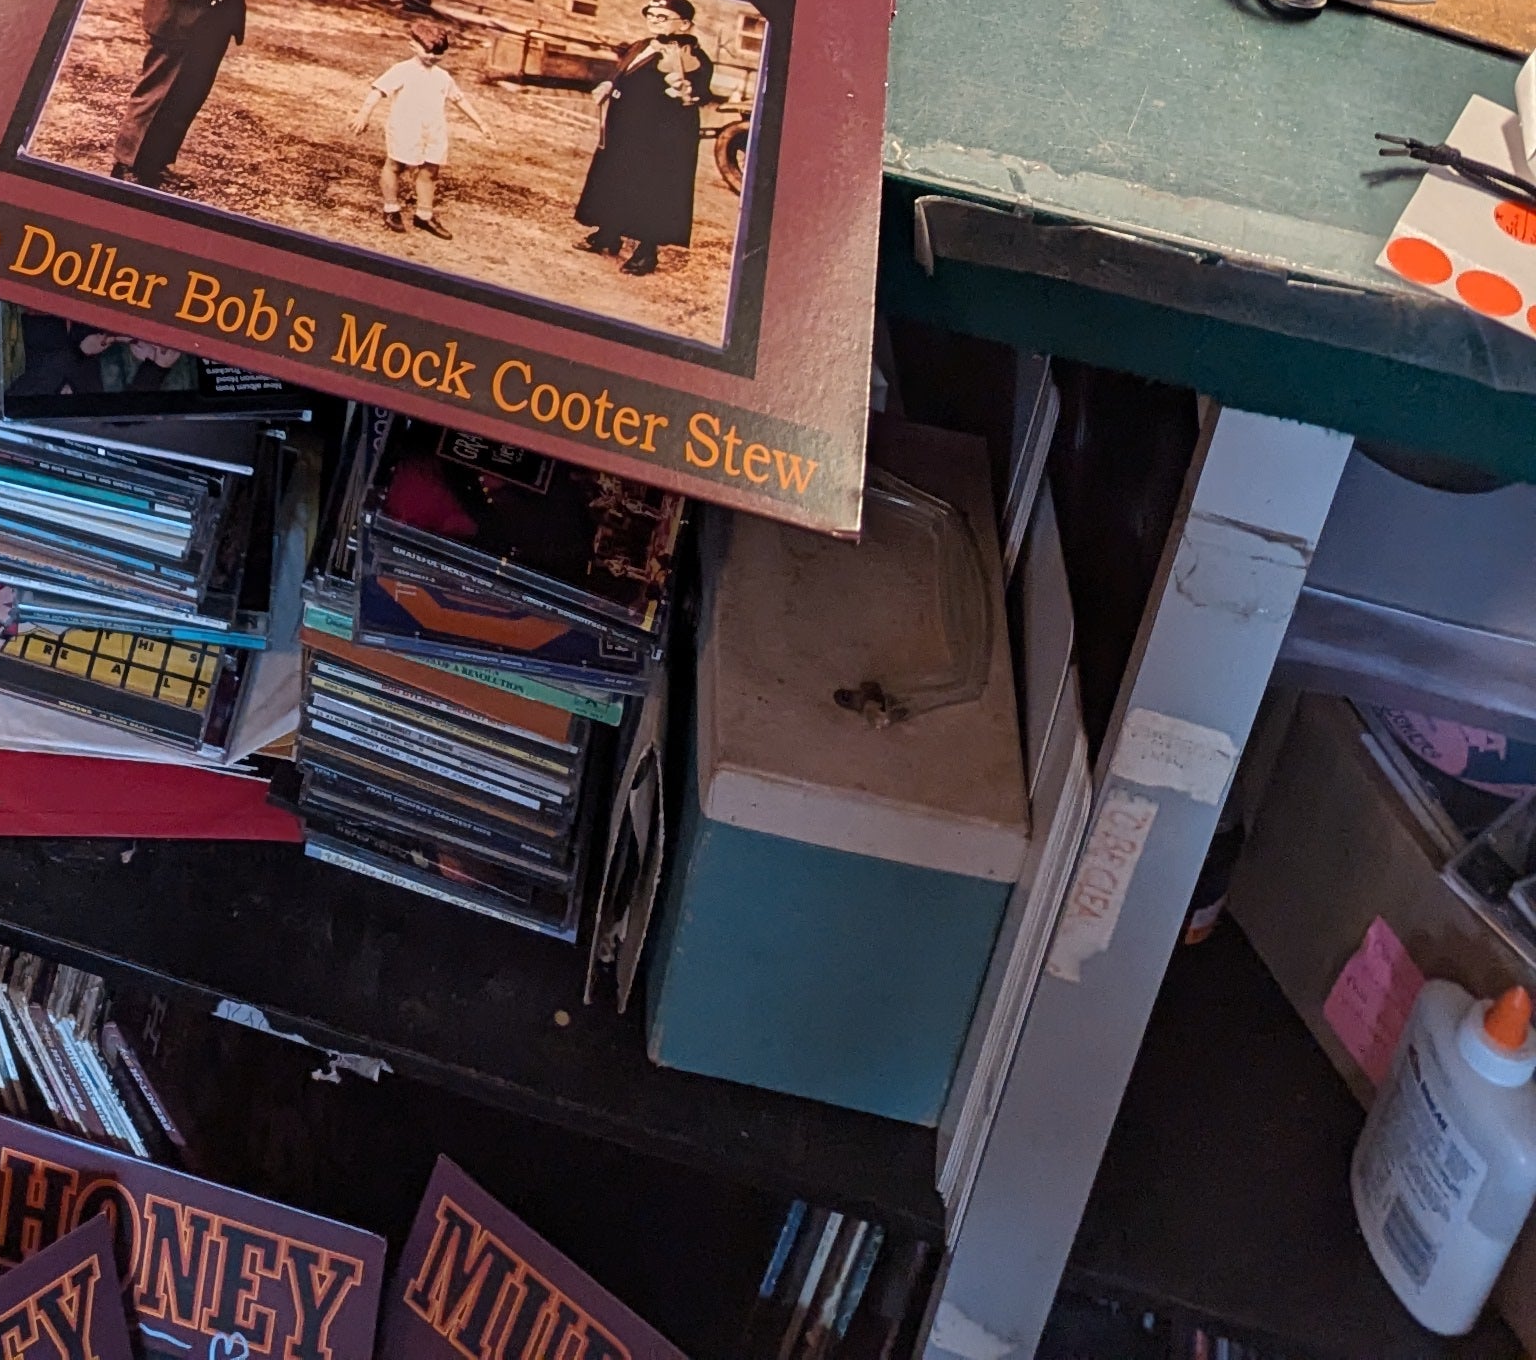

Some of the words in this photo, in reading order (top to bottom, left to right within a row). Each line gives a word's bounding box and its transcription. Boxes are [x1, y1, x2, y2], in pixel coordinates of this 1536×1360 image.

[9, 223, 168, 311] Dollar
[175, 272, 317, 354] Bob's
[331, 312, 471, 399] Mock
[491, 359, 670, 454] Cooter
[685, 410, 820, 496] Stew
